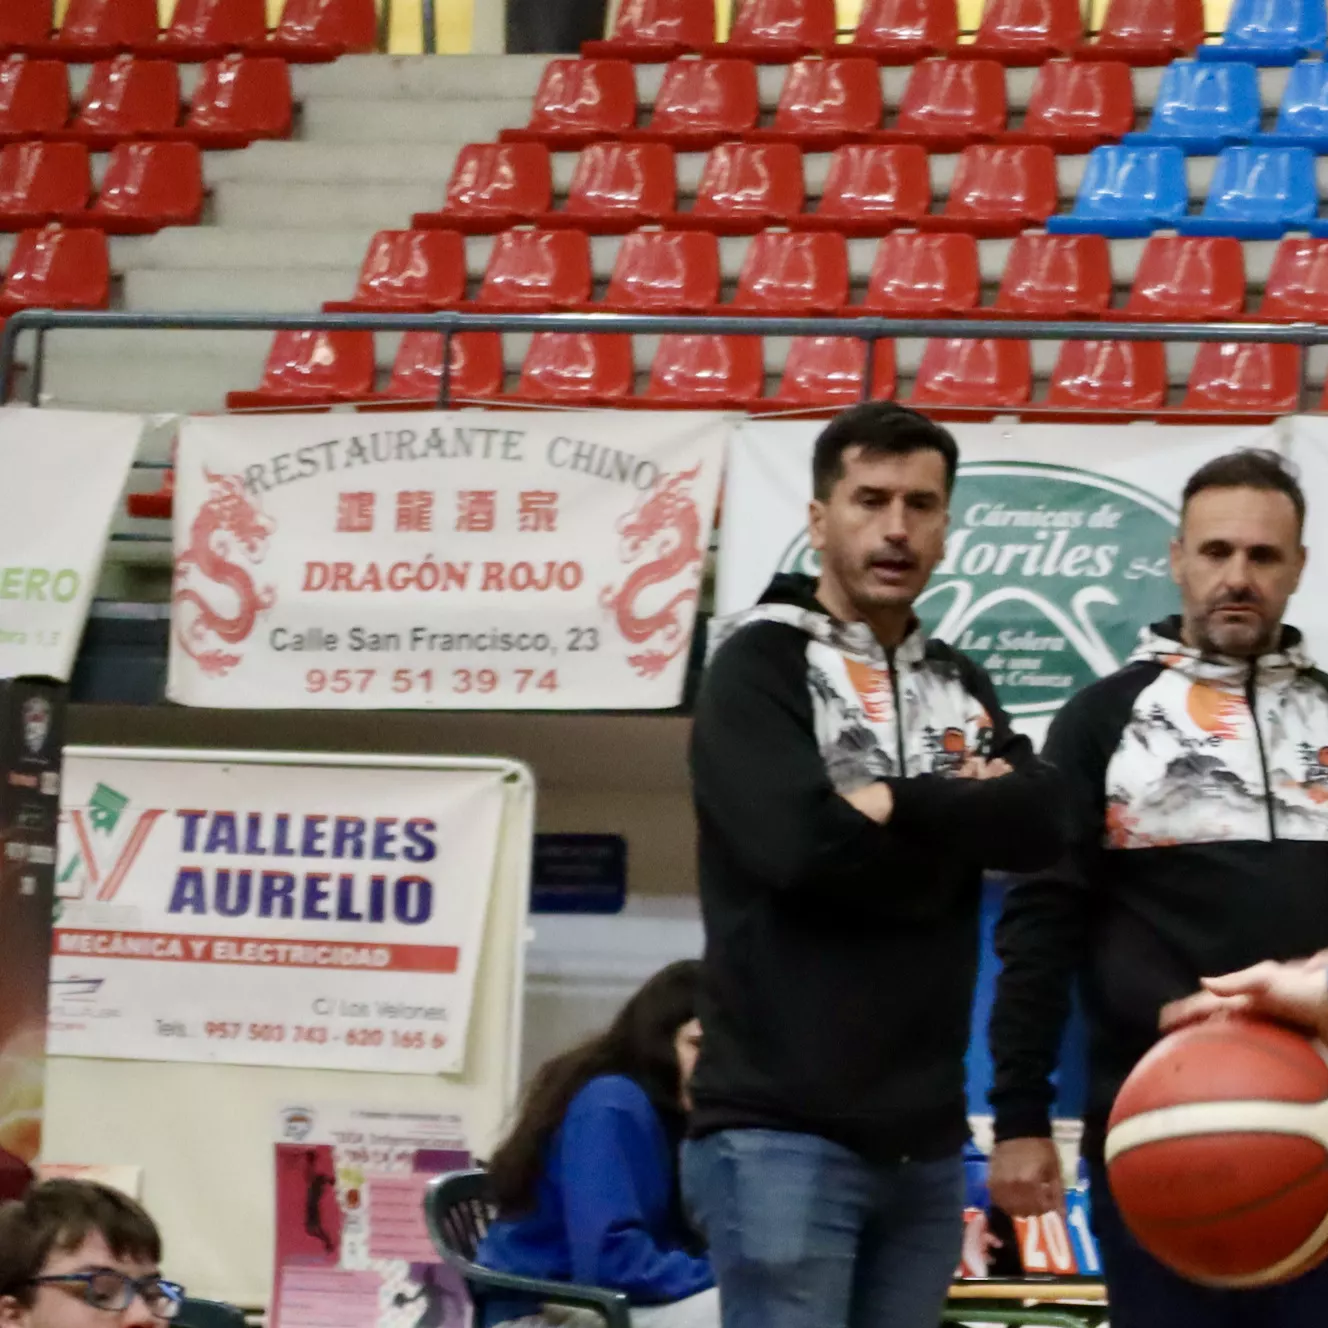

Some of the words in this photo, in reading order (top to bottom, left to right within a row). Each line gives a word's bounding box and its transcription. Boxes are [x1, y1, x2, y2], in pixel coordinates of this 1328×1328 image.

[243, 426, 526, 496] RESTAURANTE
[545, 434, 661, 492] CHINO
[1088, 503, 1123, 528] de
[302, 553, 472, 592] DRAGÓN
[480, 560, 584, 592] ROJO
[346, 627, 400, 652] San
[408, 627, 558, 656] Francisco,
[566, 627, 600, 652] 23
[305, 668, 376, 694] 957
[391, 668, 434, 693] 51
[451, 668, 499, 694] 39
[513, 668, 559, 694] 74
[174, 808, 439, 863] TALLERES
[166, 866, 434, 926] AURELIO
[190, 940, 207, 960] Y
